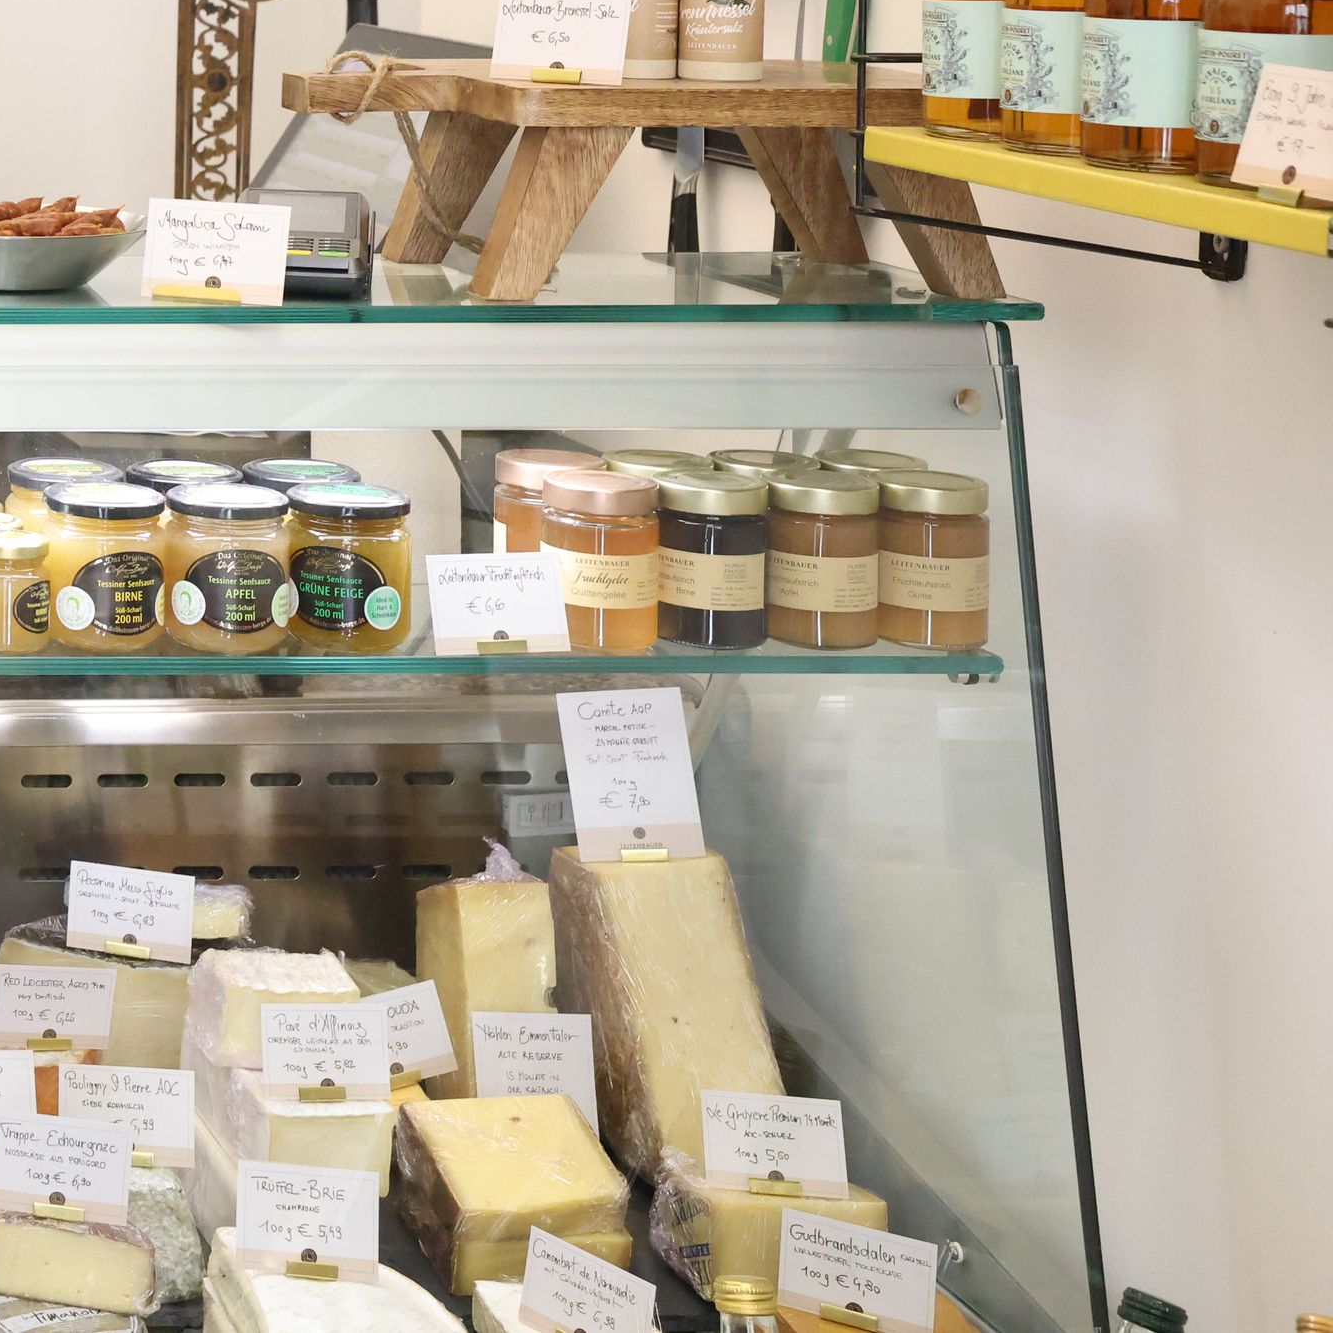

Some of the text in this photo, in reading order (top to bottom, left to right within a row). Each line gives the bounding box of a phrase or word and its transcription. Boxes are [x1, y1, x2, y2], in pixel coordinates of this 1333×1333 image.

[548, 32, 570, 46] 6,50
[687, 42, 737, 50] LEITENBAUER
[158, 210, 220, 241] Mangalica
[575, 558, 630, 567] LEITENBAUER
[891, 559, 950, 571] LEITENBAUER
[97, 580, 126, 588] Tessiner
[208, 575, 271, 586] Tessiner Senfsauce
[300, 570, 363, 585] Tessiner Senfsauce
[115, 591, 143, 602] BIRNE
[225, 588, 257, 600] APFEL
[299, 581, 364, 599] GRÜNE FEIGE
[571, 587, 627, 600] Quittengelee
[115, 613, 143, 624] 200 ml
[225, 611, 256, 621] 200 ml
[314, 607, 345, 620] 200 ml
[631, 702, 652, 715] AOP
[2, 973, 20, 986] RED
[273, 1013, 300, 1032] Pavé
[498, 1050, 563, 1061] ALTE RESERVE
[123, 1075, 151, 1093] Pierre
[155, 1077, 179, 1096] AOC
[72, 1175, 91, 1190] 6,90
[789, 1223, 896, 1265] Gudbrandsdalen
[580, 1267, 590, 1280] de
[853, 1277, 881, 1297] 4,80
